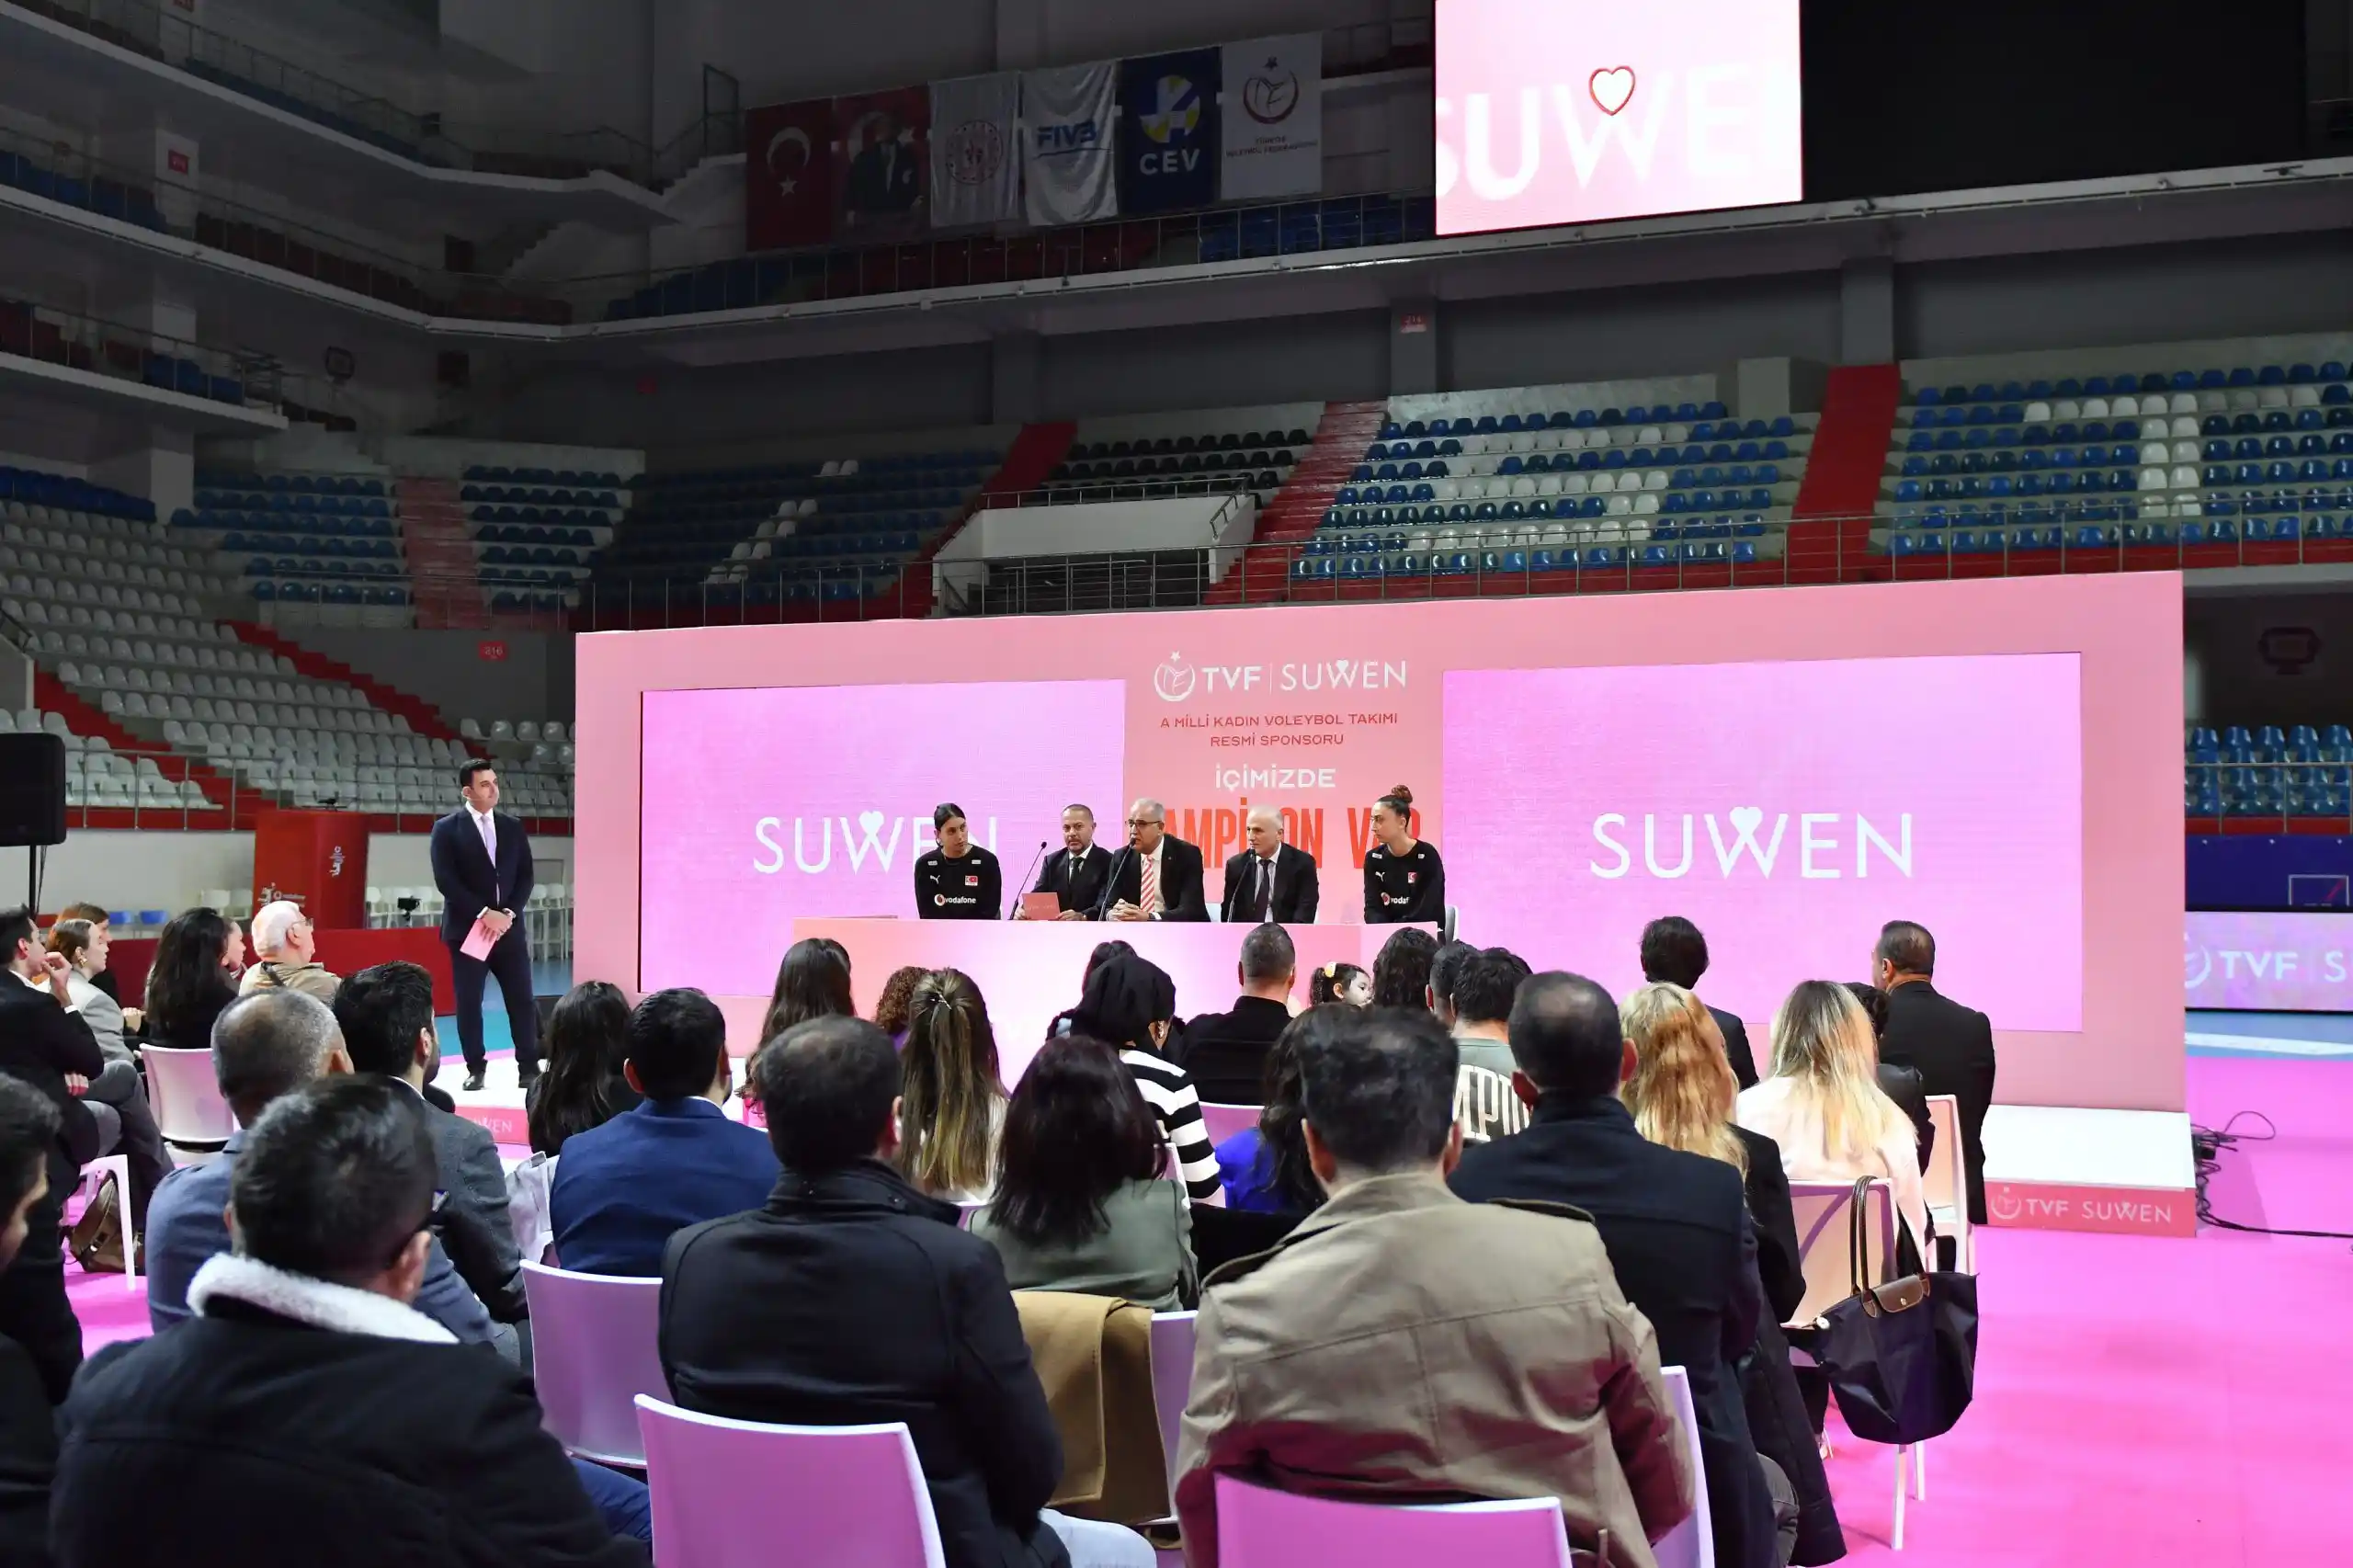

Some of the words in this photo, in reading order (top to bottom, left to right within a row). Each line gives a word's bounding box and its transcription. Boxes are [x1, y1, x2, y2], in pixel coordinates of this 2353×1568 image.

[1038, 120, 1097, 148] FIVB
[1139, 148, 1200, 176] CEV
[1201, 665, 1263, 693] TVF
[1279, 659, 1407, 691] SUWEN
[1160, 717, 1170, 728] A
[1174, 713, 1210, 728] MİLLİ
[1213, 715, 1259, 728] KADIN
[1265, 713, 1344, 726] VOLEYBOL
[1347, 711, 1398, 725] TAKIMI
[1210, 733, 1256, 747] RESMİ
[1260, 733, 1344, 747] SPONSORU
[1215, 764, 1336, 791] İÇİMİZDE
[1164, 797, 1324, 869] AMPİON
[1589, 806, 1914, 880] SUWEN
[944, 895, 977, 904] vodafone
[1391, 896, 1410, 904] vodaf
[2218, 950, 2299, 981] TVF
[2325, 950, 2353, 983] S
[474, 1116, 513, 1133] WEN
[2026, 1198, 2071, 1218] TVF
[2081, 1200, 2172, 1224] SUWEN
